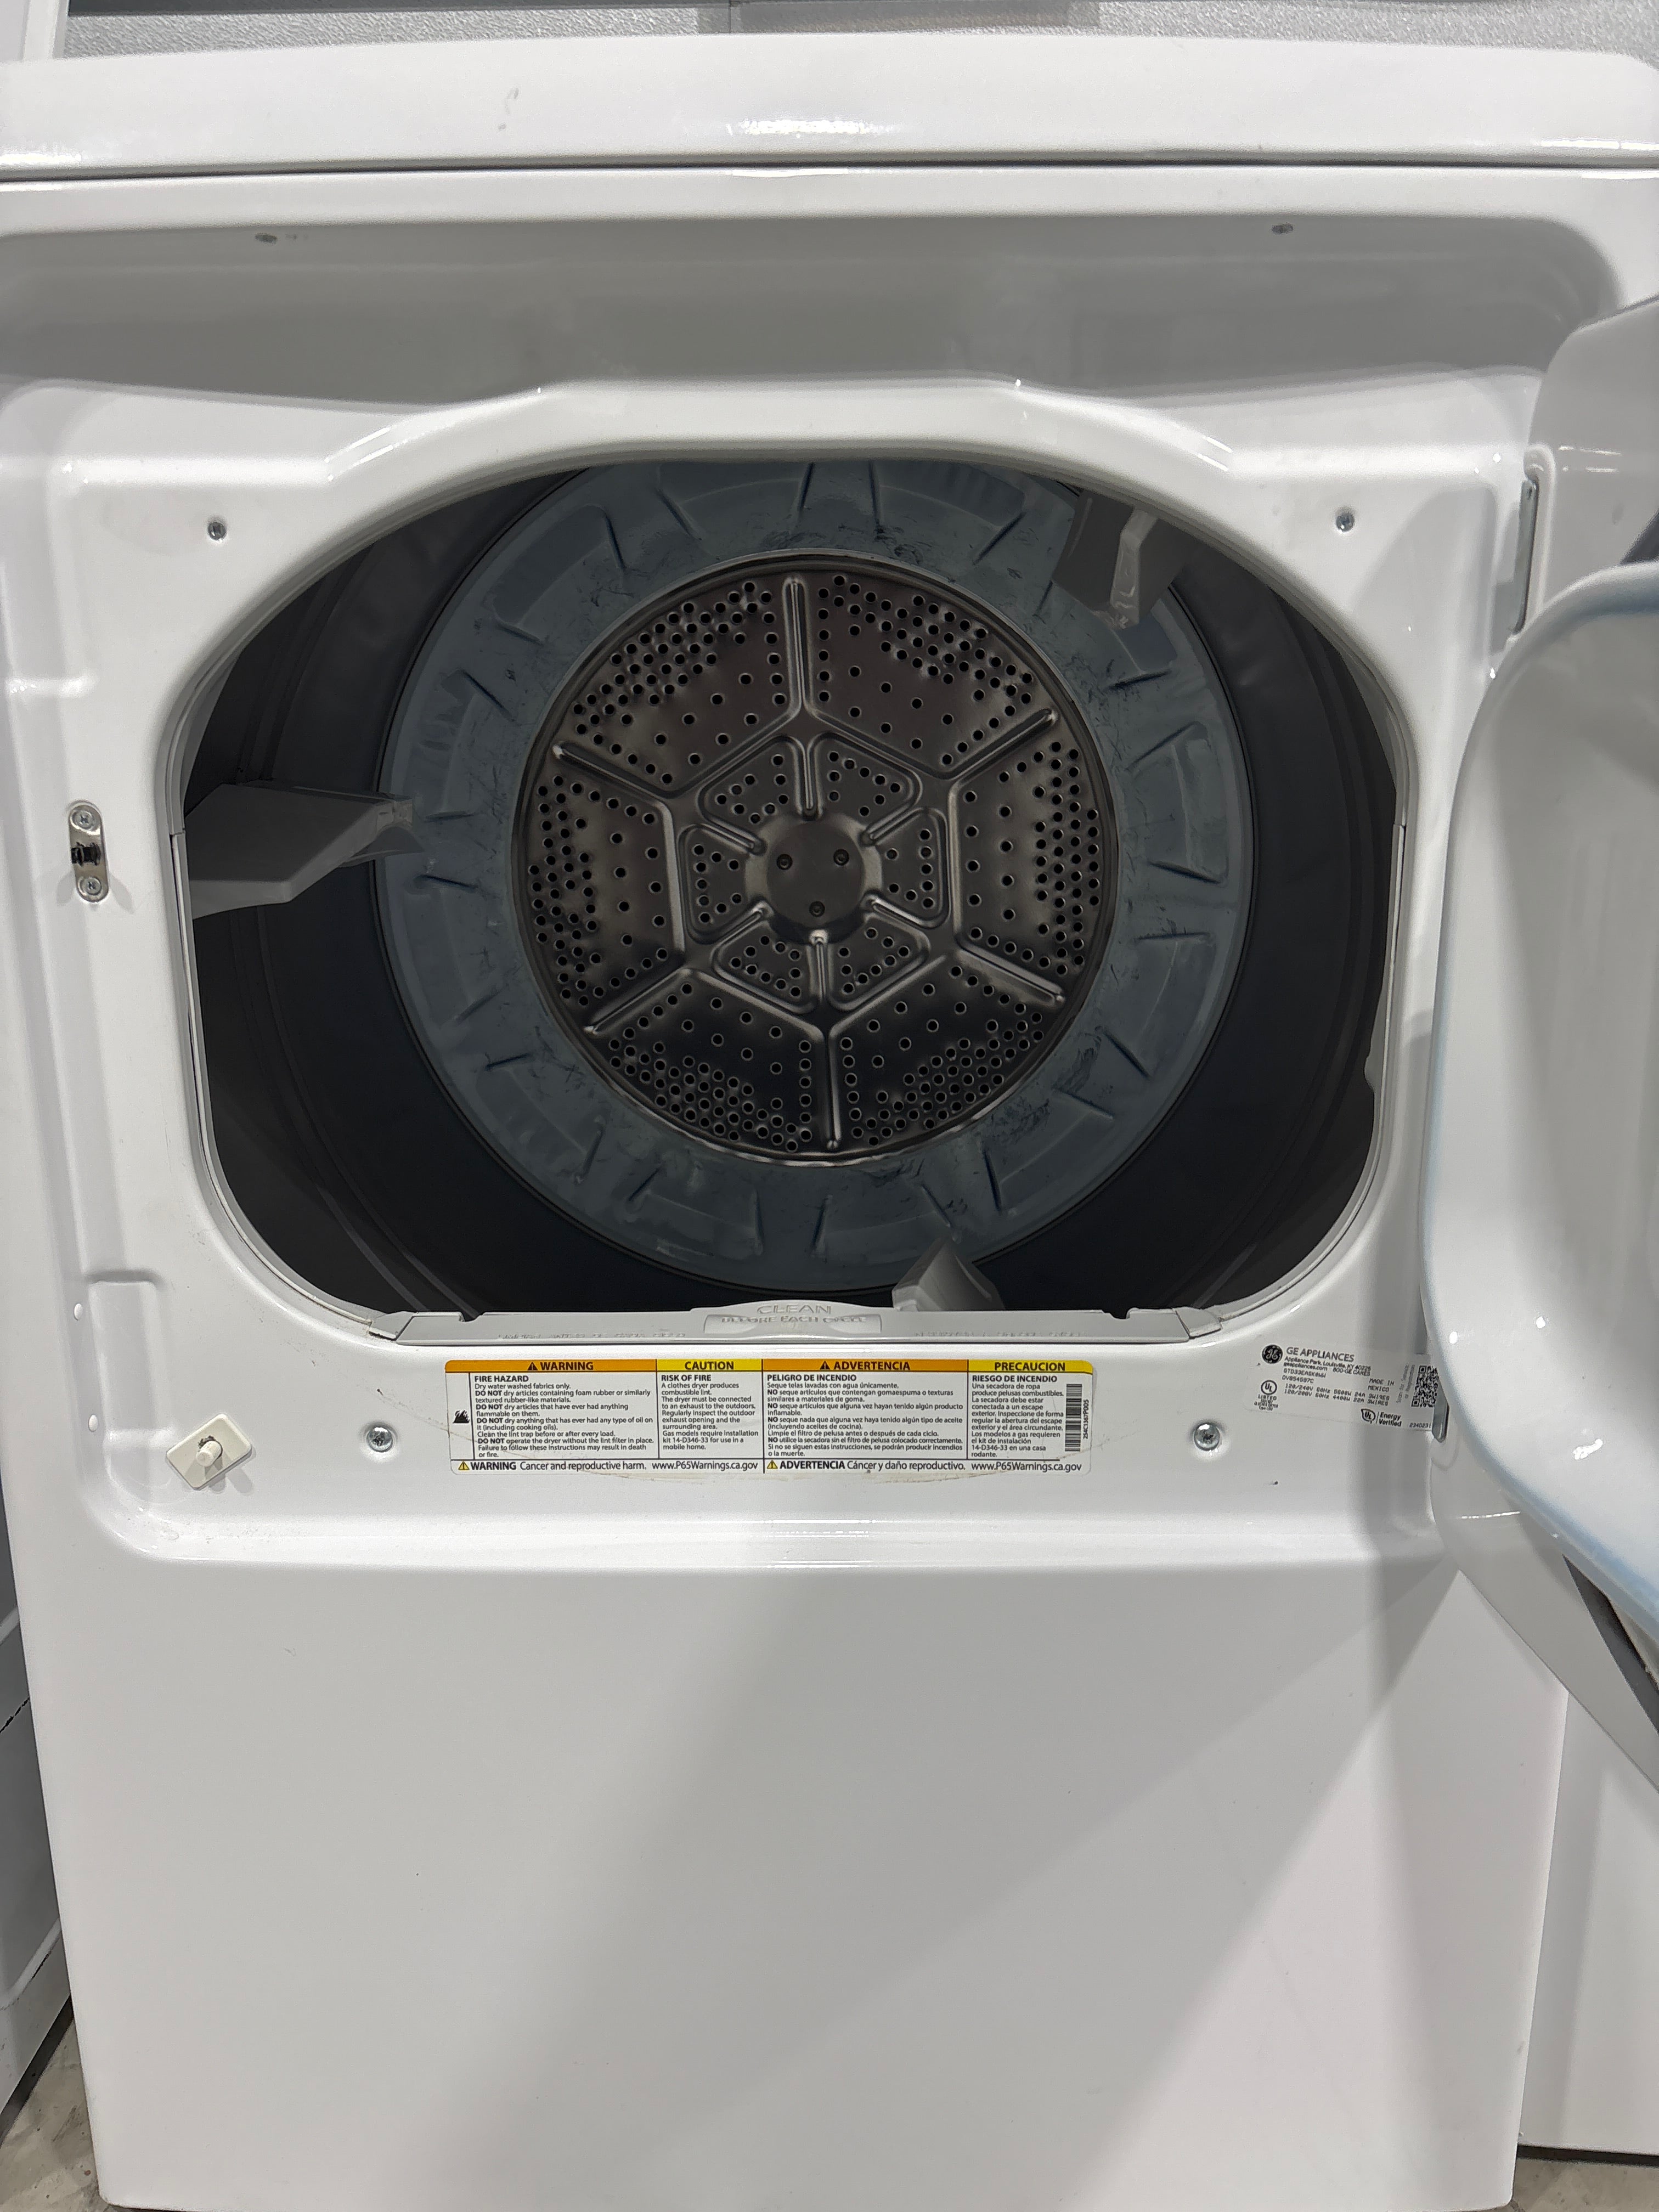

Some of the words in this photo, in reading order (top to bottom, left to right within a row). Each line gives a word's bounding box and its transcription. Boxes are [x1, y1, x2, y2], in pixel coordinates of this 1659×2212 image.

[757, 1305, 831, 1314] CLEAN
[1286, 1346, 1299, 1355] GE
[1300, 1348, 1355, 1362] APPLIANCES
[540, 1362, 594, 1370] WARNING
[685, 1361, 734, 1370] CAUTION
[833, 1361, 911, 1370] ADVERTENCIA
[994, 1362, 1065, 1371] PRECAUCION
[1380, 1412, 1401, 1421] Energy
[1379, 1419, 1402, 1427] Verified
[471, 1462, 517, 1470] WARNING
[521, 1462, 549, 1470] Cancer
[550, 1461, 566, 1470] and
[568, 1461, 620, 1471] reproductive
[623, 1461, 646, 1470] harm.
[652, 1461, 758, 1471] www.P65Warnings.ca.gov
[780, 1460, 845, 1469] ADVERTENCIA
[847, 1460, 877, 1470] Cáncer
[878, 1463, 884, 1471] y
[885, 1460, 907, 1470] daño
[909, 1460, 966, 1471] reproductivo.
[971, 1462, 1082, 1472] www.P65Warnings.ca.gov
